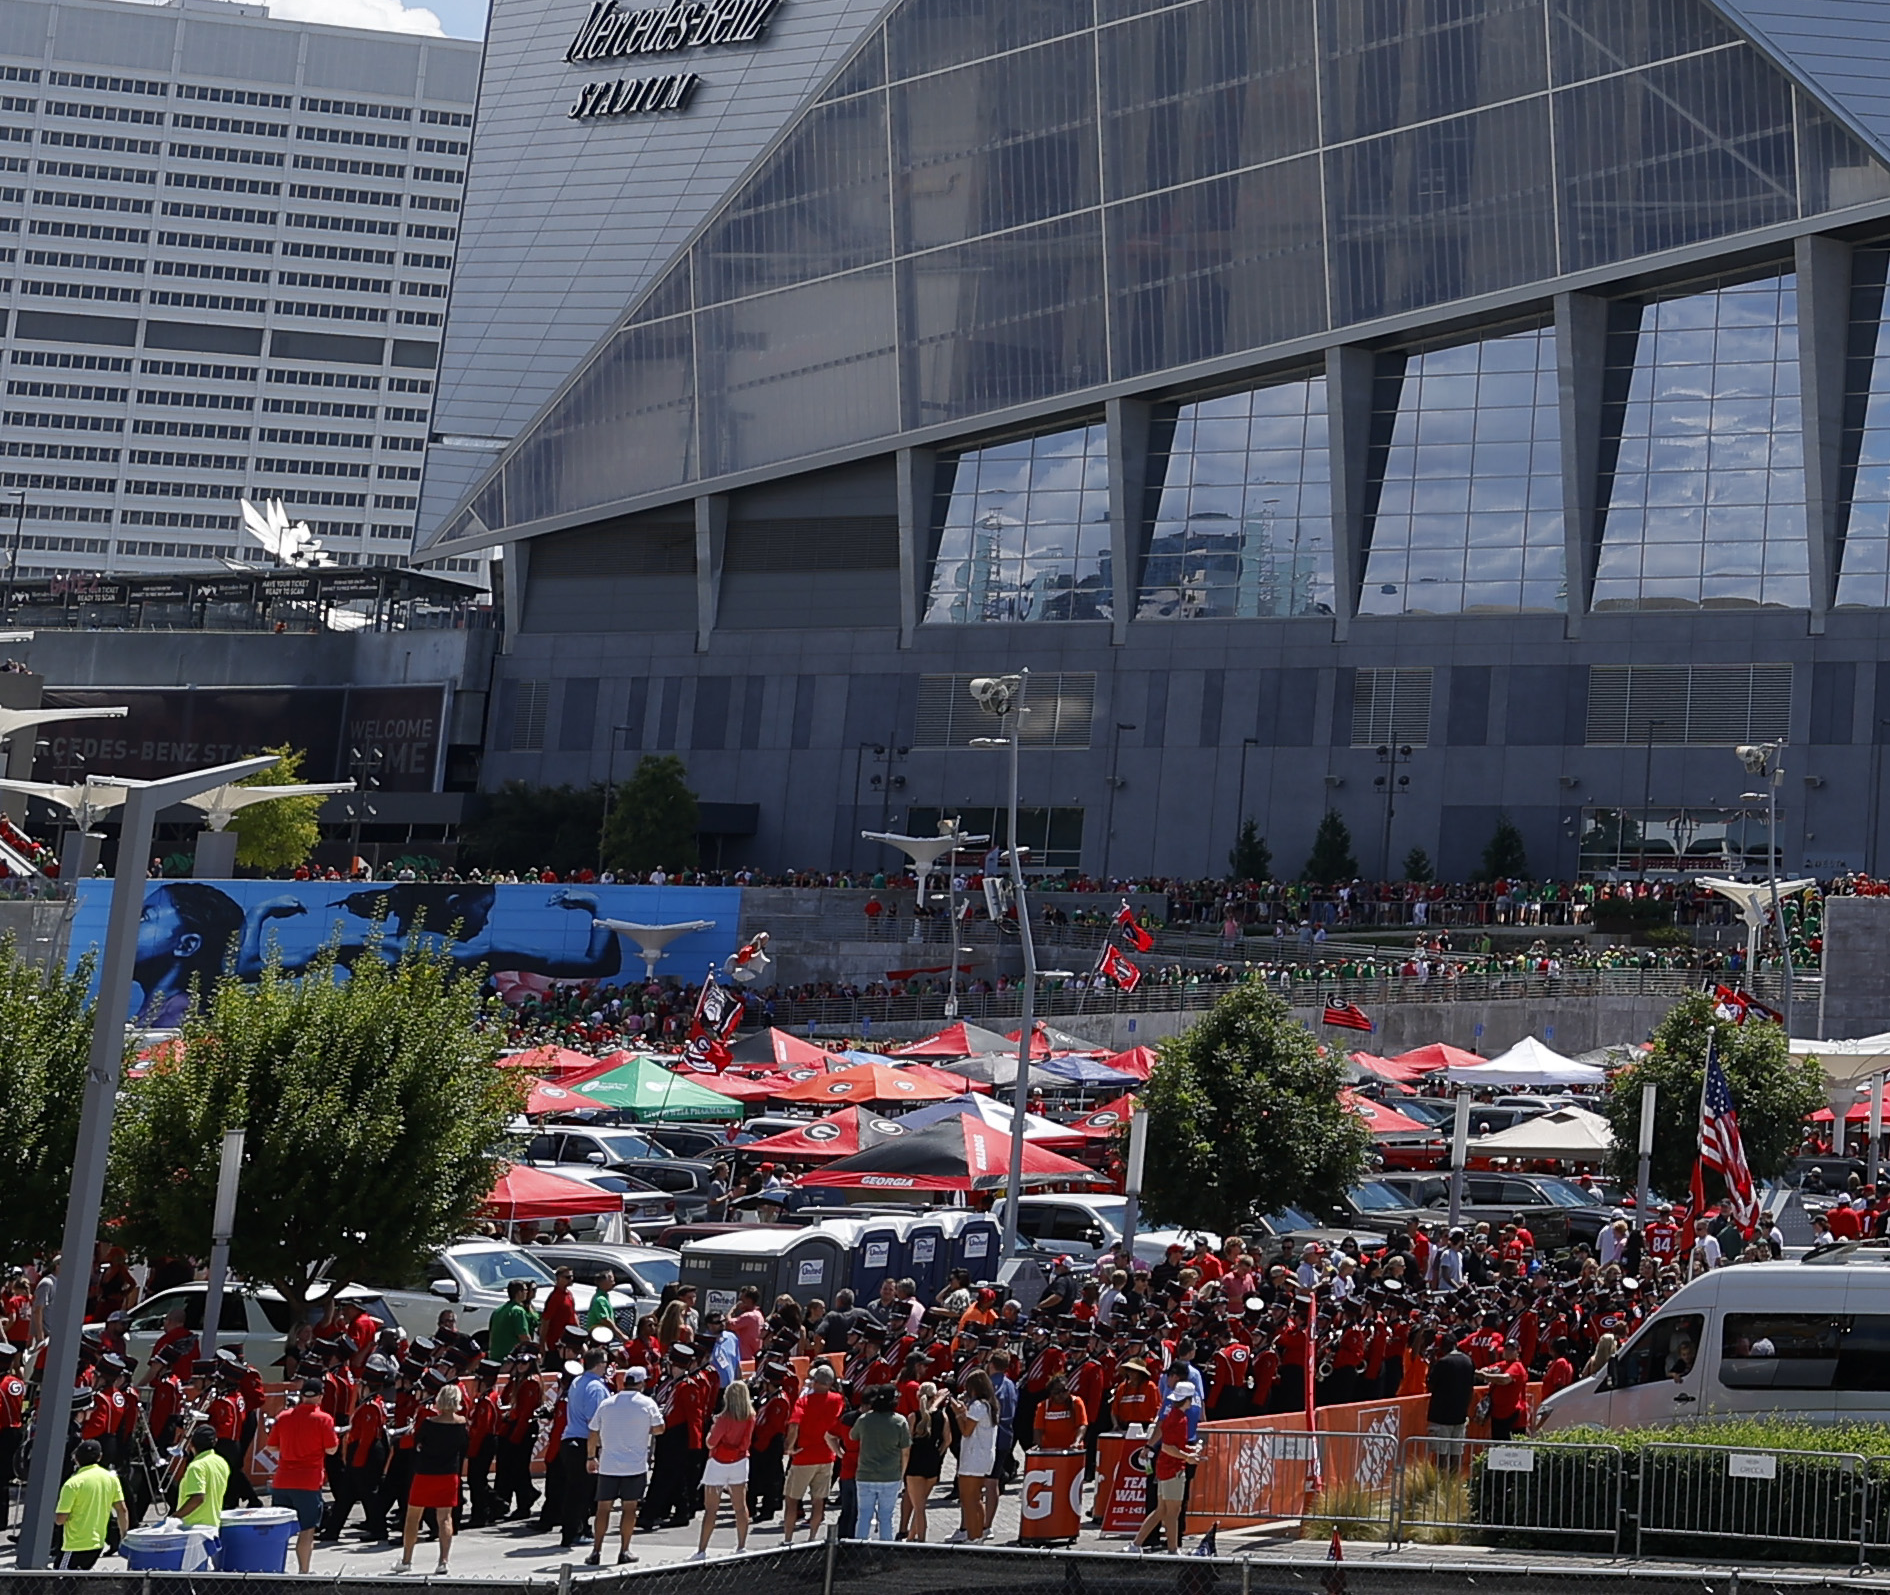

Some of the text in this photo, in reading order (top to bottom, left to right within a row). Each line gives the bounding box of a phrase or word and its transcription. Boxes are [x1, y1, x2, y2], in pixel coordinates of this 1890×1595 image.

[568, 73, 698, 119] STADIUM
[350, 718, 433, 740] WELCOME
[861, 1175, 915, 1188] GEORGIA
[1652, 1236, 1672, 1254] 84
[801, 1263, 822, 1276] United
[708, 1293, 737, 1306] United
[1123, 1476, 1147, 1488] TEA
